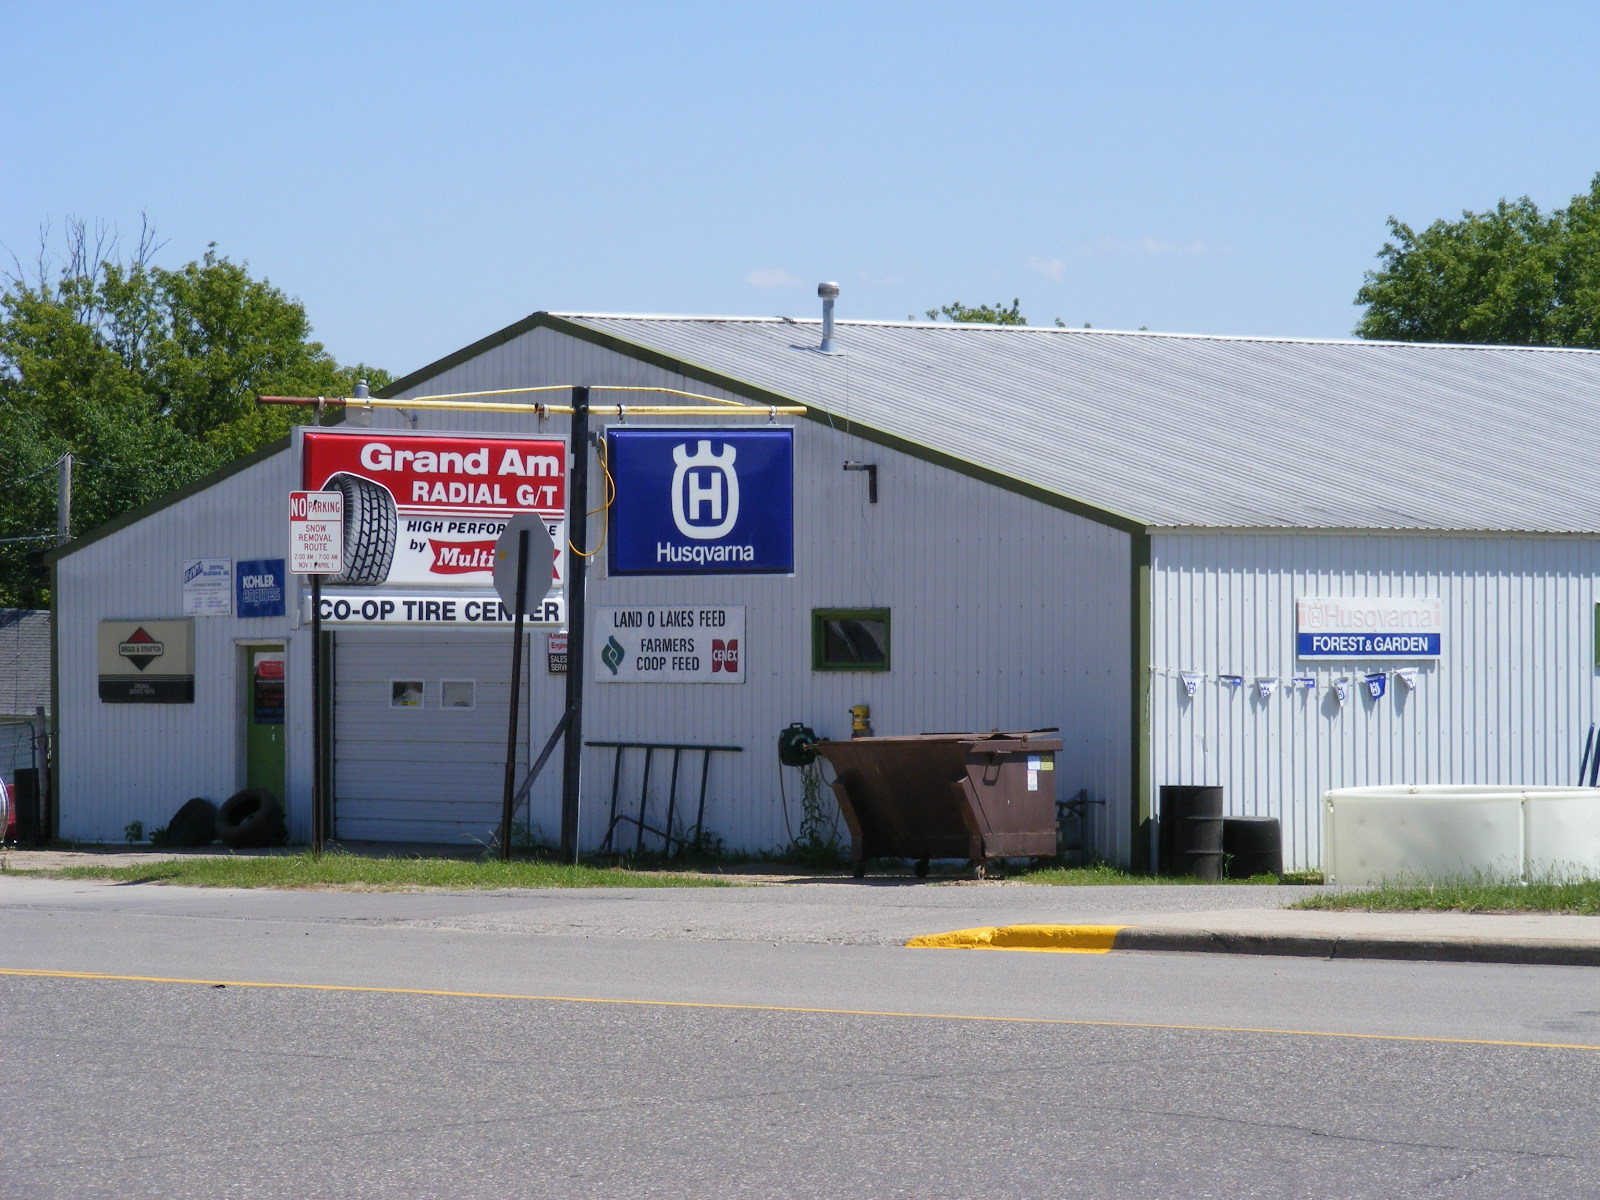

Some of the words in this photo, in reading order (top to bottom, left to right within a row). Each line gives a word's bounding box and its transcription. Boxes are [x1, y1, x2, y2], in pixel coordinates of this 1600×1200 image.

[360, 442, 489, 476] Grand
[497, 449, 559, 477] Am
[412, 481, 507, 505] RADIAL
[516, 485, 557, 506] G/T
[291, 498, 307, 517] NO
[308, 501, 340, 513] PARKING
[305, 524, 327, 533] SNOW
[406, 520, 444, 533] HIGH
[447, 522, 557, 536] PERFORE
[299, 533, 333, 542] REMOVAL
[304, 543, 328, 551] ROUTE
[409, 539, 426, 553] by
[656, 542, 755, 565] Husqvarna
[436, 547, 494, 568] Multi
[242, 575, 275, 589] KOHLER
[242, 588, 281, 606] engines
[319, 599, 395, 622] CO-OP
[402, 600, 457, 621] TIRE
[464, 600, 560, 622] CENER
[1325, 604, 1433, 631] Husqvarna
[614, 611, 643, 628] LAND
[647, 611, 655, 628] O
[660, 611, 694, 628] LAKES
[700, 610, 726, 627] FEED
[640, 638, 695, 653] FARMERS
[1312, 636, 1365, 651] FOREST
[1374, 636, 1428, 651] GARDEN
[550, 655, 567, 663] SALES
[712, 649, 738, 662] CENEX
[636, 656, 666, 671] COOP
[672, 656, 700, 671] FEED
